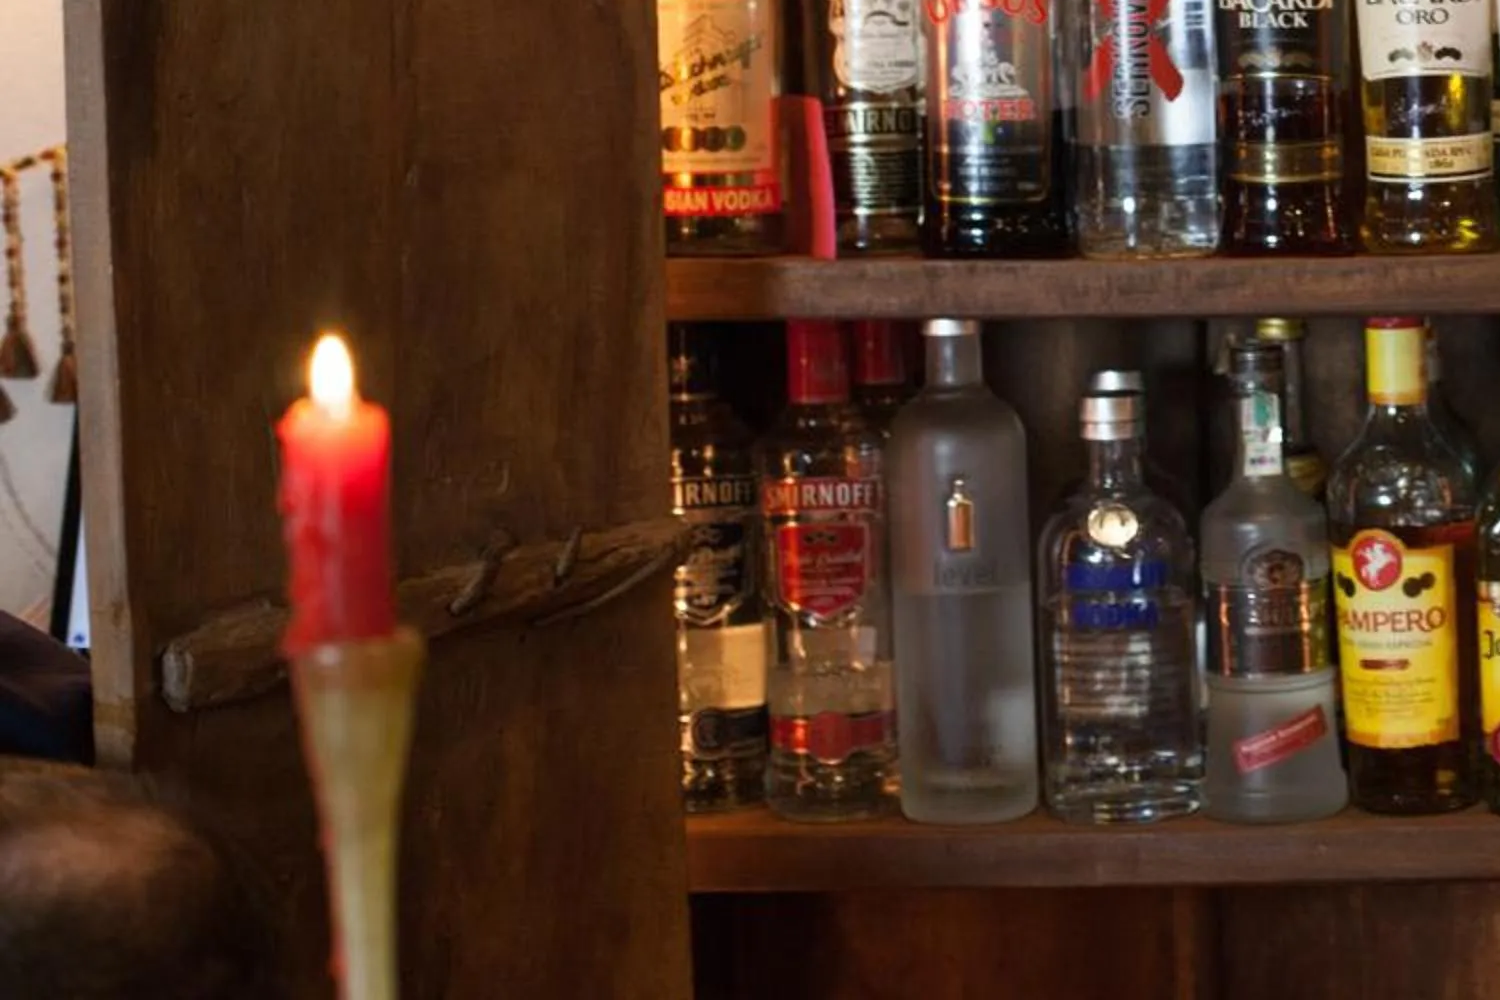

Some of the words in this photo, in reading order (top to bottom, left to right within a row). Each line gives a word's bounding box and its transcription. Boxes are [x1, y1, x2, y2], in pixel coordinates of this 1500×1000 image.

[1239, 11, 1309, 28] BLACK
[1395, 7, 1450, 25] ORO
[664, 189, 708, 211] SIAN
[709, 187, 774, 211] VODKA
[765, 481, 872, 508] SMIRNOFF
[1340, 605, 1447, 633] AMPERO
